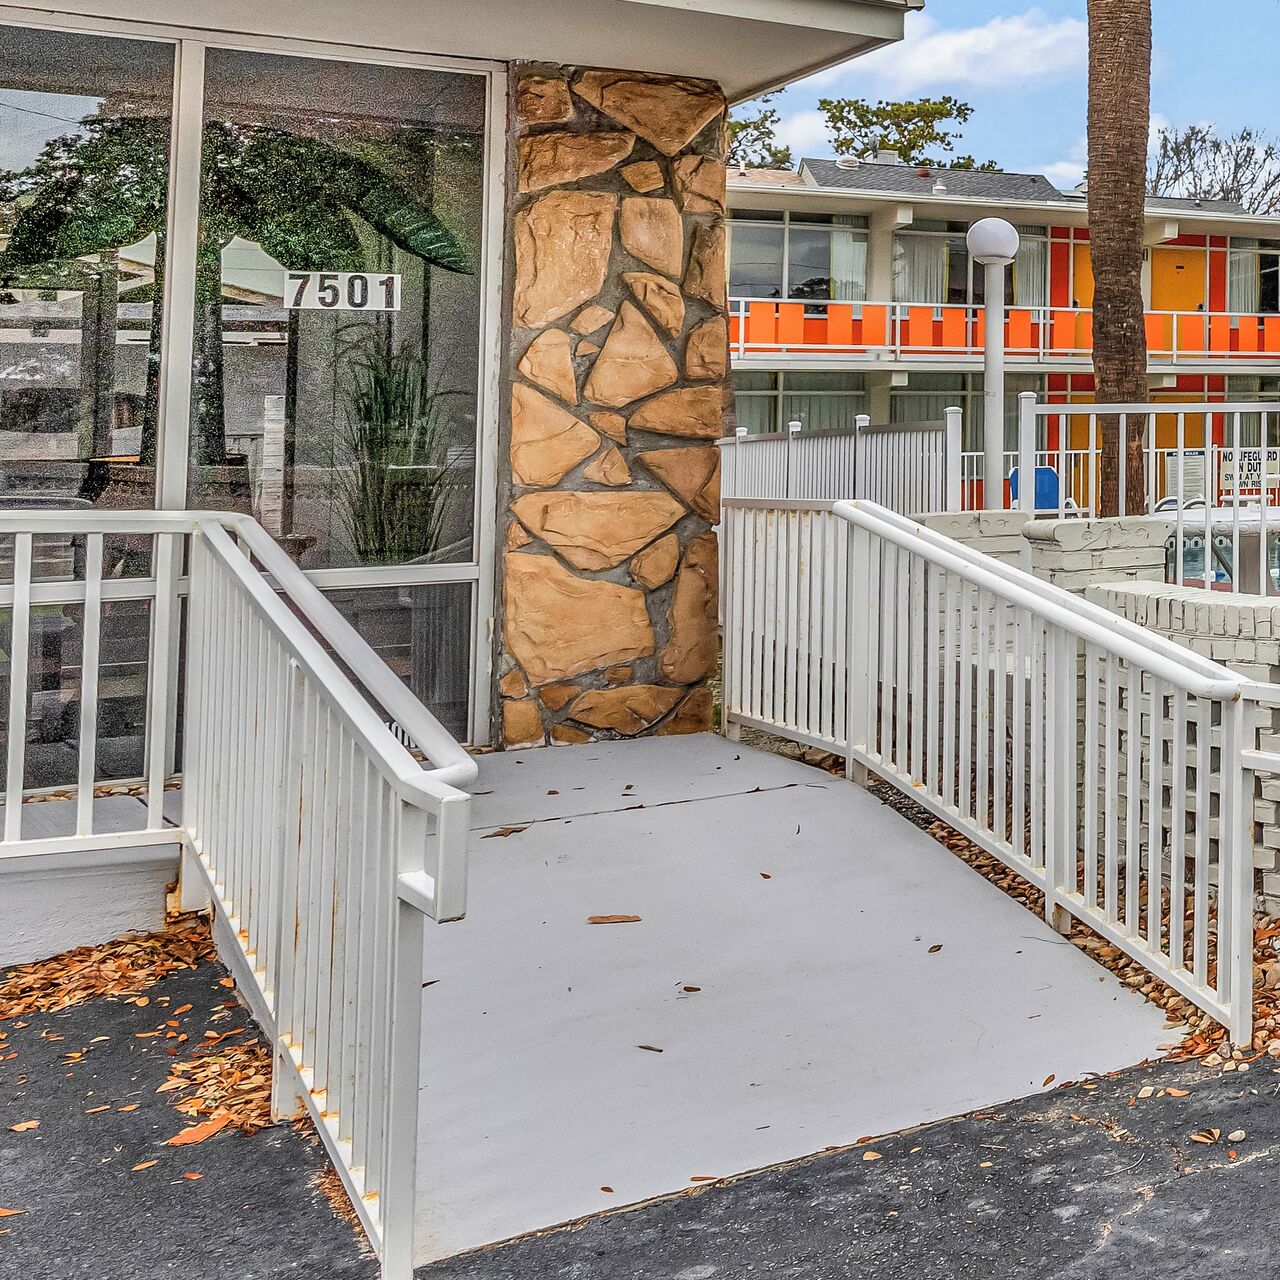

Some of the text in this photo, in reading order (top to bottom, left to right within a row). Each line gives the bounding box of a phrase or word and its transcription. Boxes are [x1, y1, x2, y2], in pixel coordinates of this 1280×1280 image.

[288, 273, 395, 309] 7501
[1222, 450, 1278, 462] NO IFEGURD
[1247, 462, 1262, 473] DUT
[1251, 480, 1262, 488] RIS
